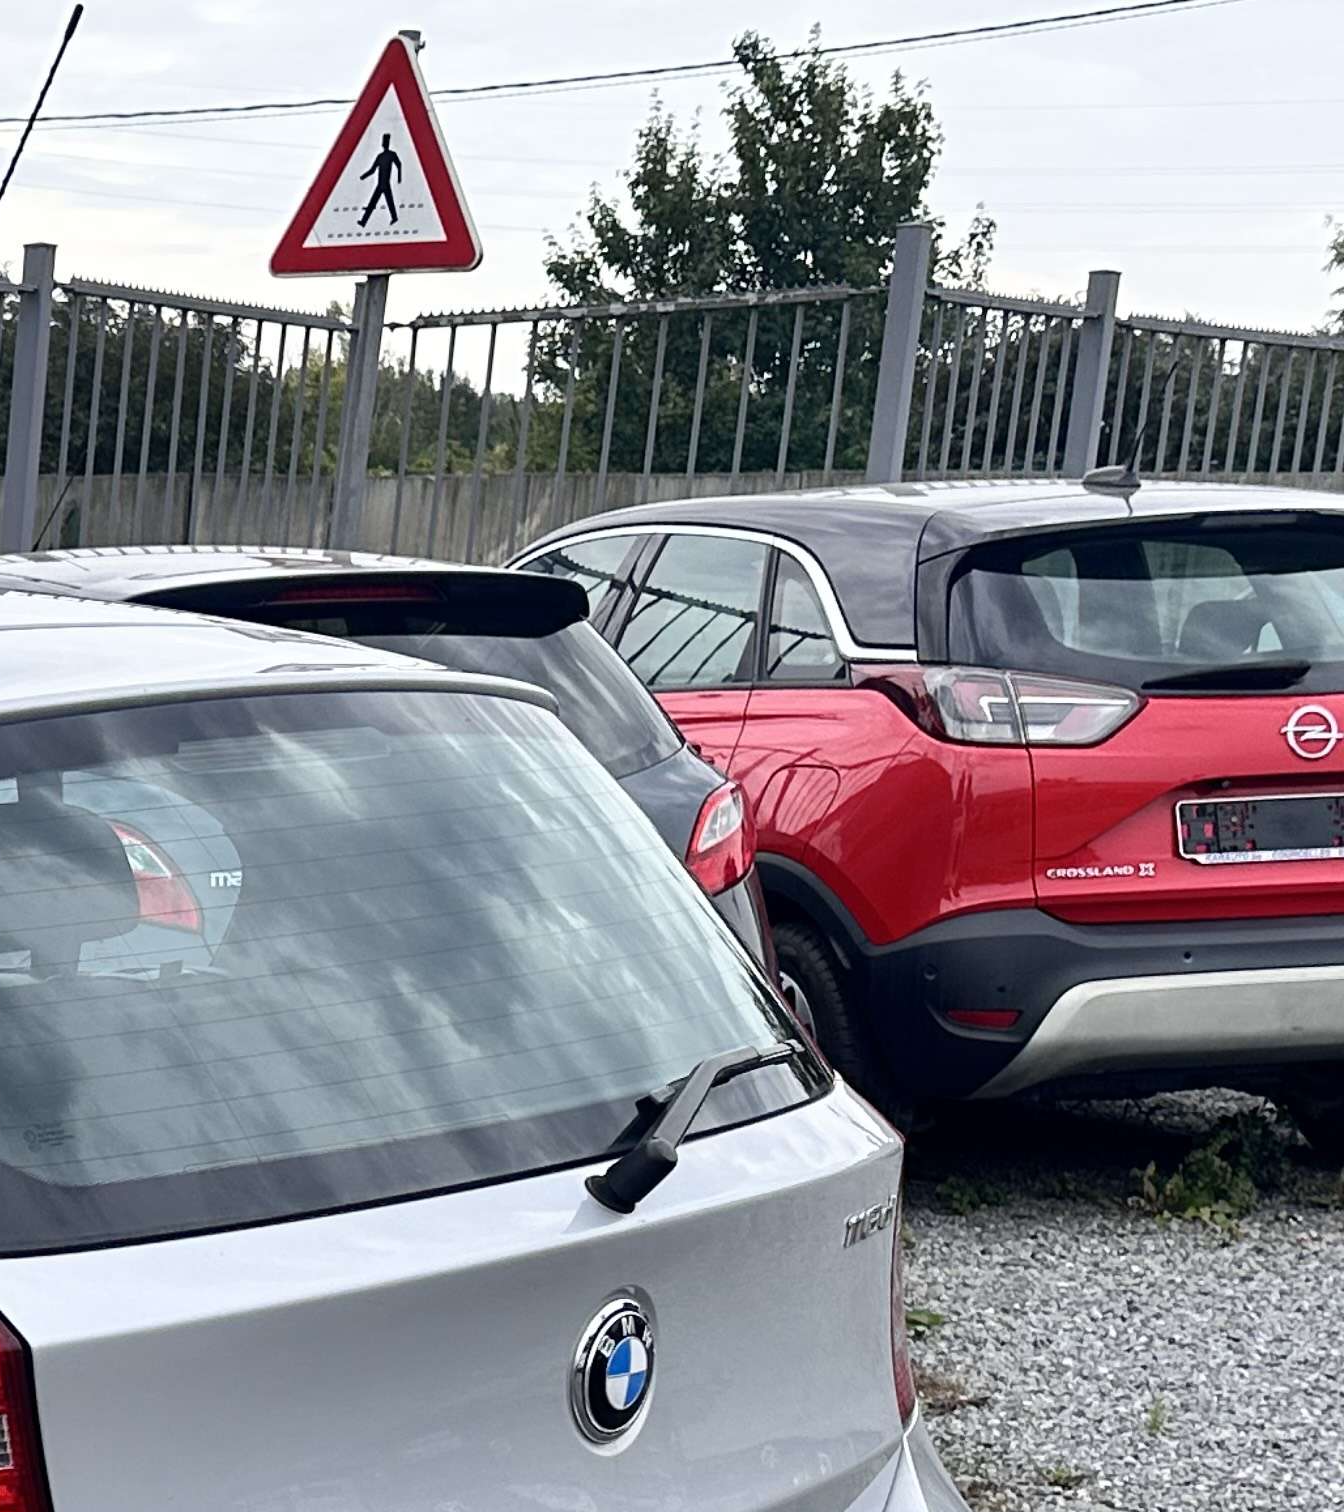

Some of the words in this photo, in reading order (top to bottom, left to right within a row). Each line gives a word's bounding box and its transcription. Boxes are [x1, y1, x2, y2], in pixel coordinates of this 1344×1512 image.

[1046, 865, 1135, 879] CROSSLAND
[1138, 862, 1156, 877] X
[597, 1314, 653, 1358] BMW
